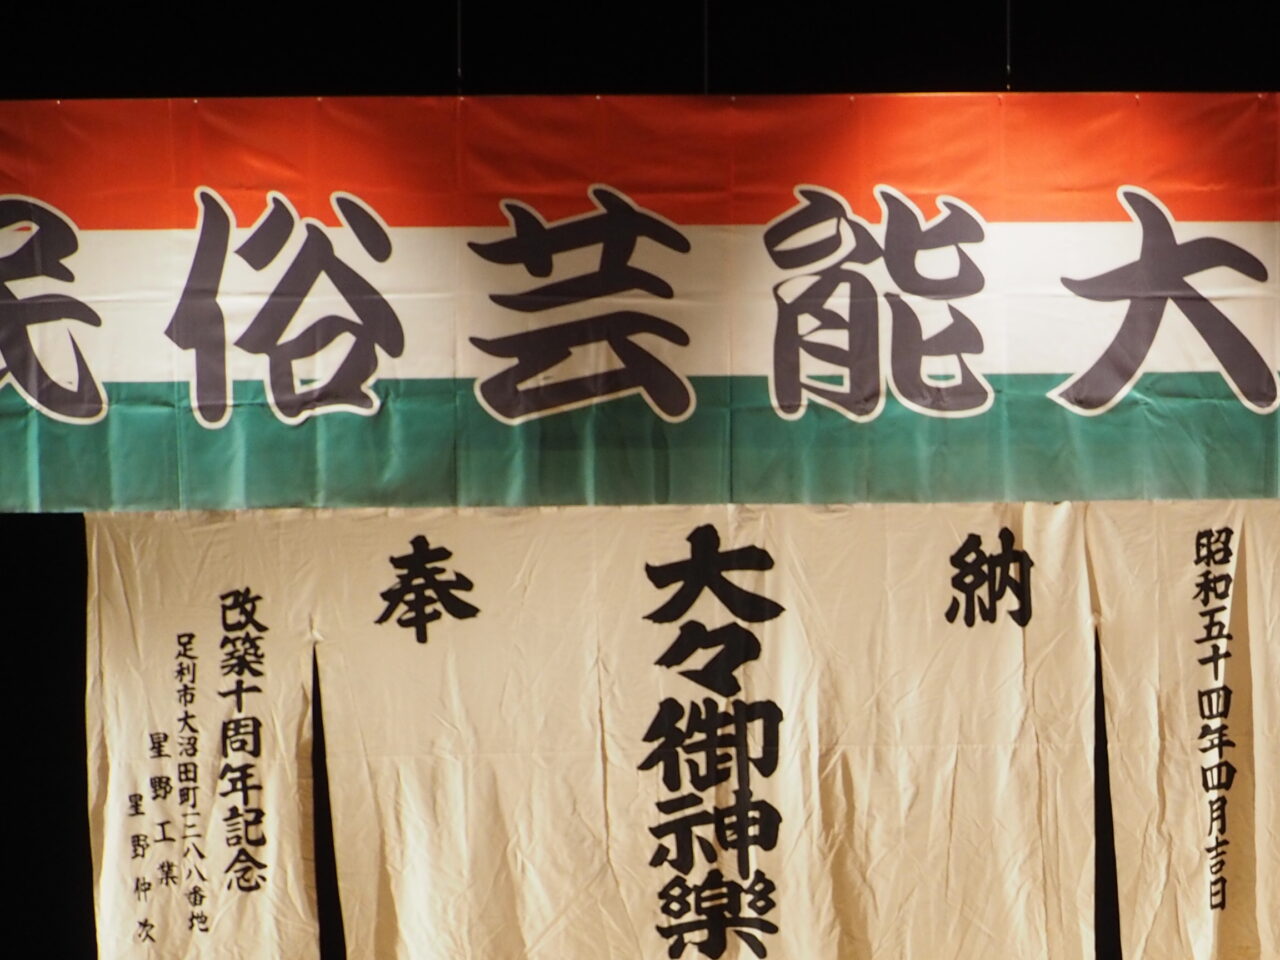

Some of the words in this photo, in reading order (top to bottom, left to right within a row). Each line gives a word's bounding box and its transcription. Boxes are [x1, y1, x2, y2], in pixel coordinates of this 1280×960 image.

[374, 534, 481, 644] 奉
[945, 527, 1034, 628] 納
[217, 586, 269, 894] 改築十周年記念
[1193, 526, 1238, 911] 昭和五十四年四月吉日
